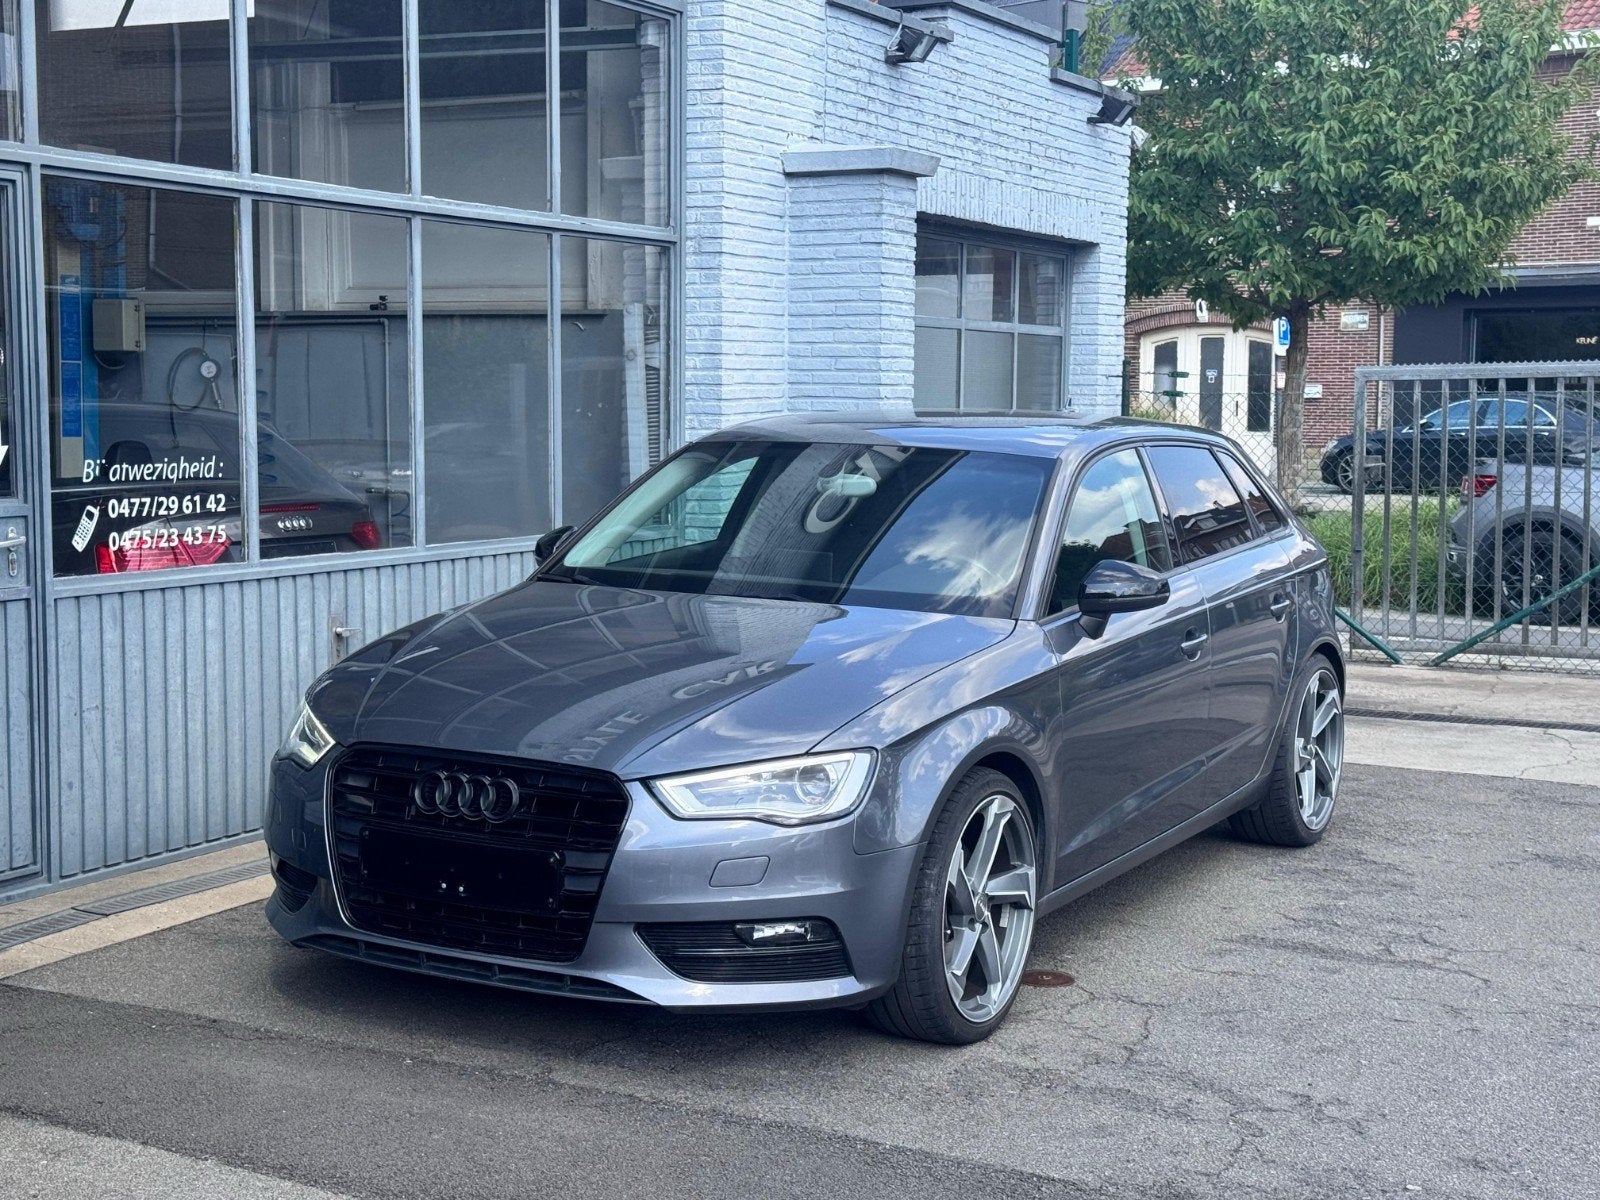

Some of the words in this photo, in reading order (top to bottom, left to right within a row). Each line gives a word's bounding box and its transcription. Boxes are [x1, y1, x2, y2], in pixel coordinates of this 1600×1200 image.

[82, 459, 107, 483] Bi
[107, 496, 179, 518] 0477/29
[182, 494, 201, 514] 61
[206, 493, 226, 513] 42
[108, 528, 179, 551] 0475/23
[183, 526, 203, 545] 43
[206, 525, 227, 543] 75
